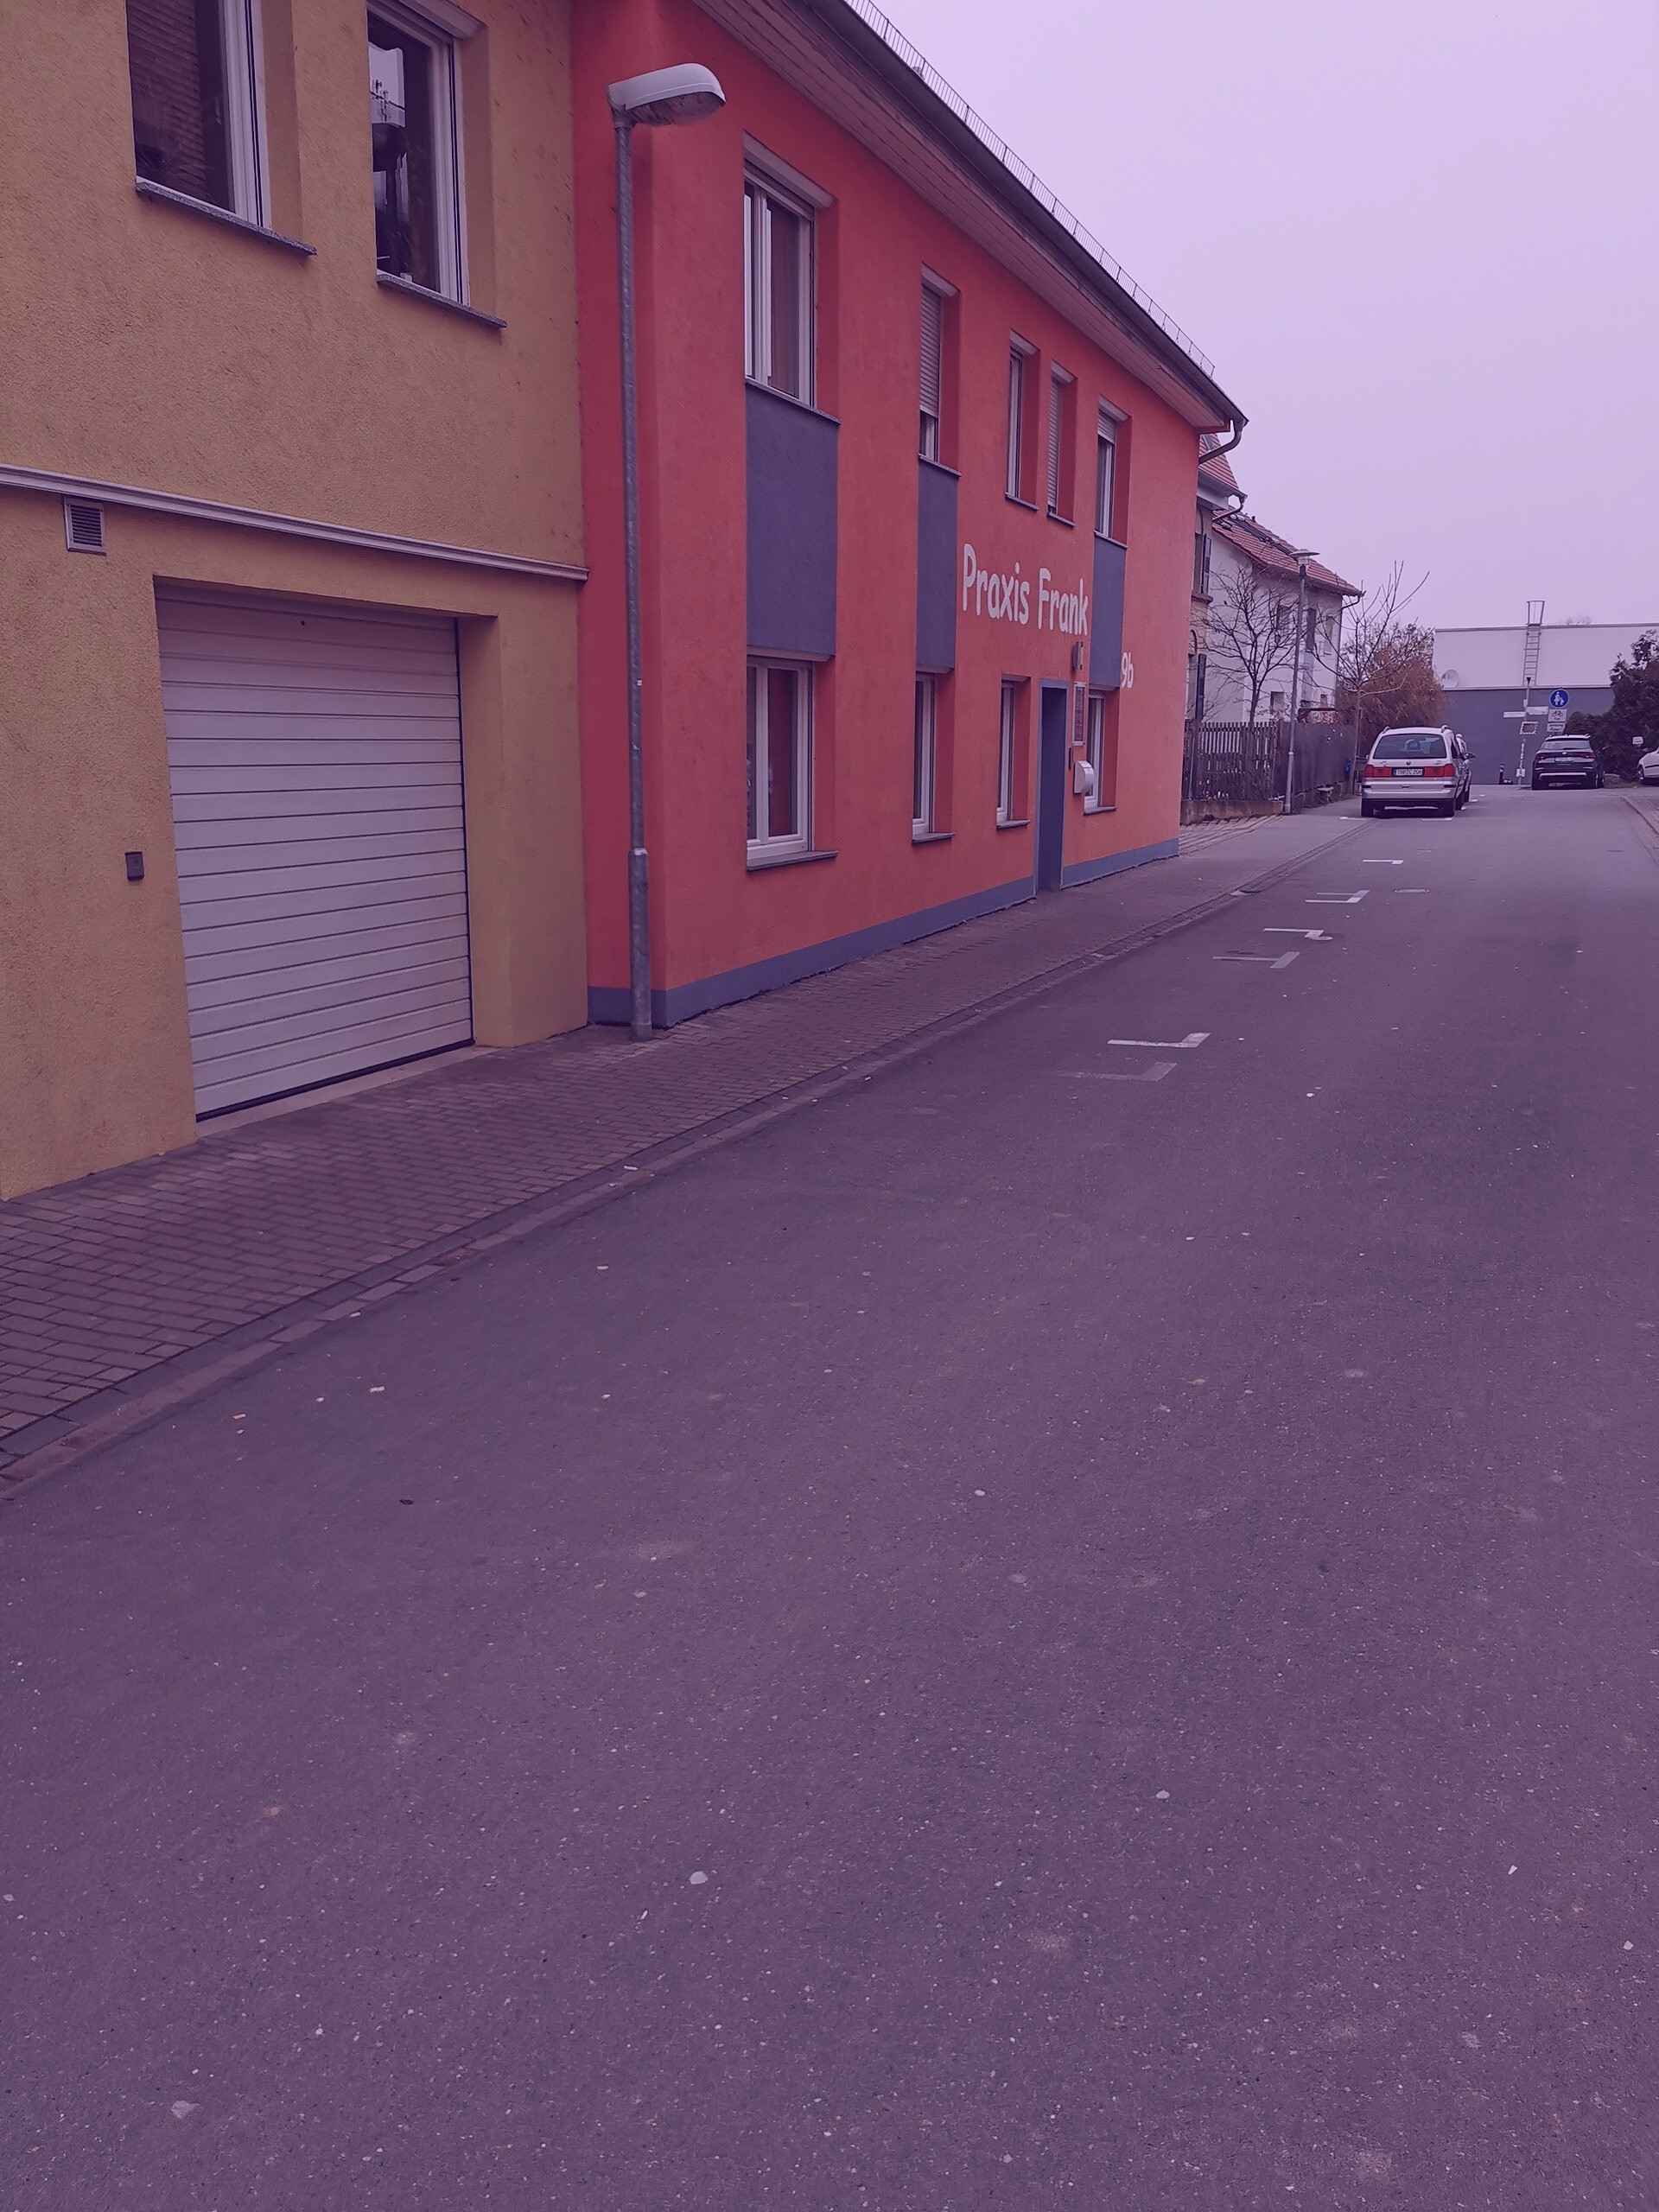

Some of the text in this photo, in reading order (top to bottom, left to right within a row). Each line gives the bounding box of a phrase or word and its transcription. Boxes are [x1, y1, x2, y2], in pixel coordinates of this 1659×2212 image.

[963, 543, 1089, 636] Praxis Frank
[1121, 652, 1135, 689] 9b
